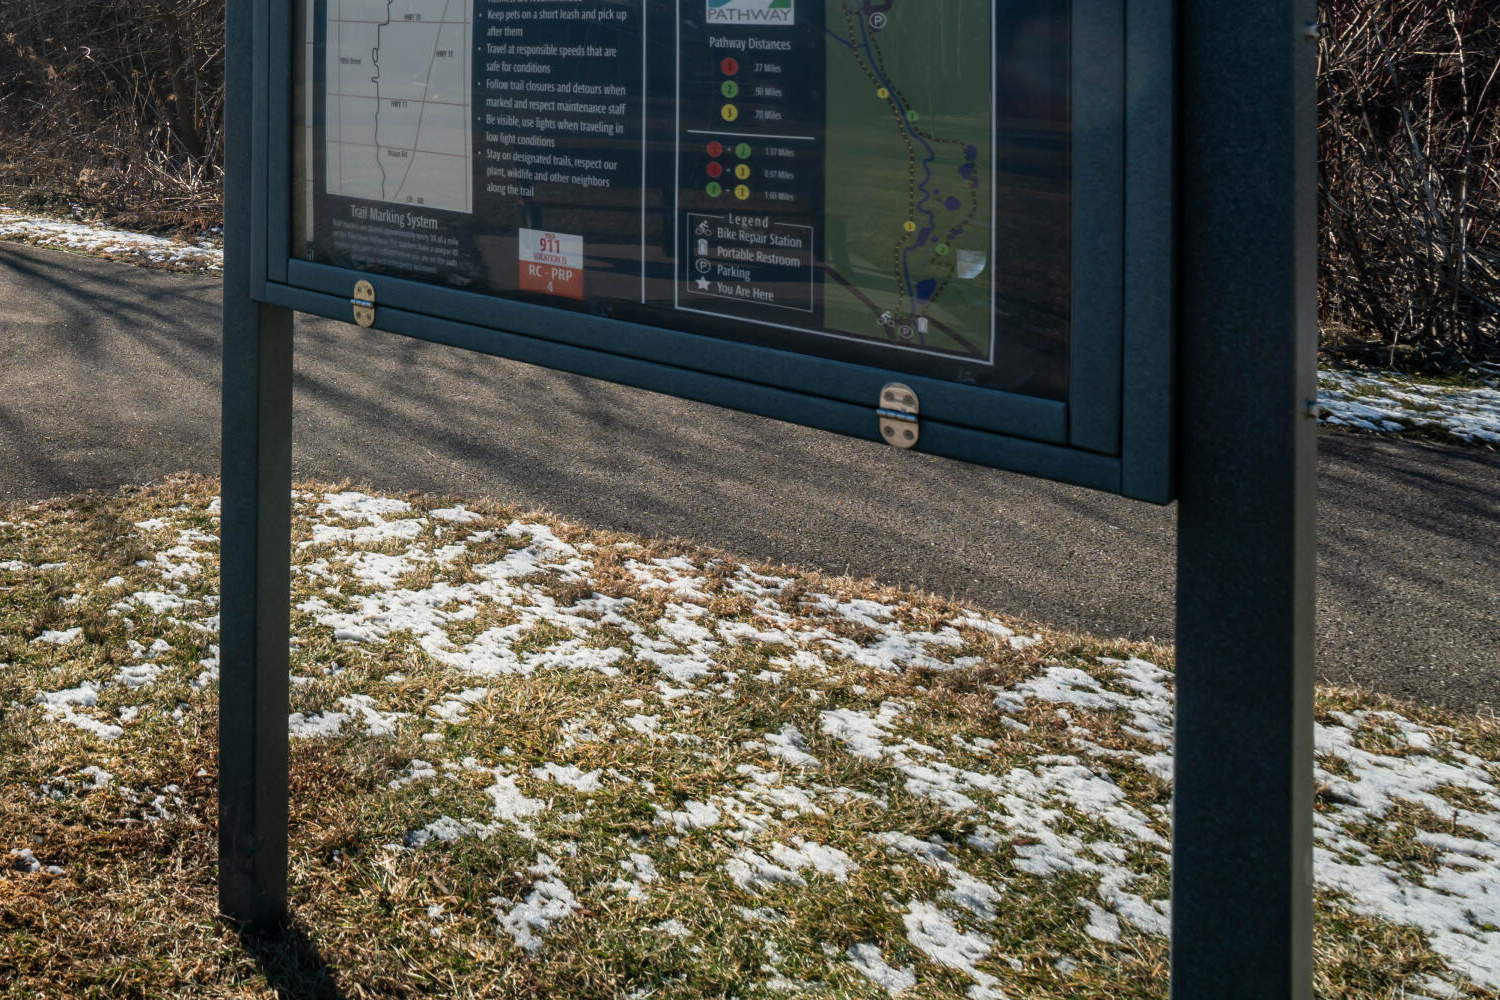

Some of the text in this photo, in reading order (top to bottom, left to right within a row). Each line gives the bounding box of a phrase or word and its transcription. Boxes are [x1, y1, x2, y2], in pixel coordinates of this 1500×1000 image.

[488, 9, 627, 22] Keep pets on a short leash and pick up
[708, 9, 791, 21] PATHWAY
[487, 26, 523, 36] after them
[486, 44, 616, 58] Travel at responsible speeds that are
[709, 37, 791, 51] Pathway Distances
[486, 61, 551, 73] safe for conditions
[764, 63, 781, 73] Miles
[486, 79, 626, 95] Follow trail closures and detours when
[765, 88, 782, 96] Miles
[486, 98, 626, 115] marked and respect maintenance staff
[765, 111, 781, 120] Miles
[486, 115, 496, 125] Be
[522, 118, 534, 128] use
[536, 118, 556, 131] lights
[558, 120, 578, 130] when
[580, 123, 614, 136] traveling
[616, 123, 624, 133] in
[486, 133, 555, 147] low light conditions
[487, 149, 500, 161] Stay
[503, 152, 511, 161] on
[513, 152, 551, 165] designated
[575, 158, 602, 170] respect
[604, 161, 618, 169] our
[779, 148, 796, 157] Miles
[508, 169, 533, 179] wildlife
[534, 172, 548, 181] and
[550, 173, 570, 183] other
[572, 175, 610, 188] neighbors
[778, 171, 795, 180] Miles
[487, 183, 534, 196] along the trail
[778, 193, 795, 202] Miles
[350, 205, 367, 219] Trail
[370, 208, 405, 227] Marking
[407, 213, 437, 230] System
[729, 213, 769, 228] Legend
[717, 228, 802, 248] Bike Repair Station
[540, 238, 560, 254] 911
[534, 253, 560, 262] LOCATION
[717, 247, 800, 267] Portable Restroom
[529, 264, 542, 277] RC
[552, 268, 572, 281] PRP
[717, 265, 751, 282] Parking
[548, 281, 553, 292] 4
[717, 282, 774, 301] You Are Here
